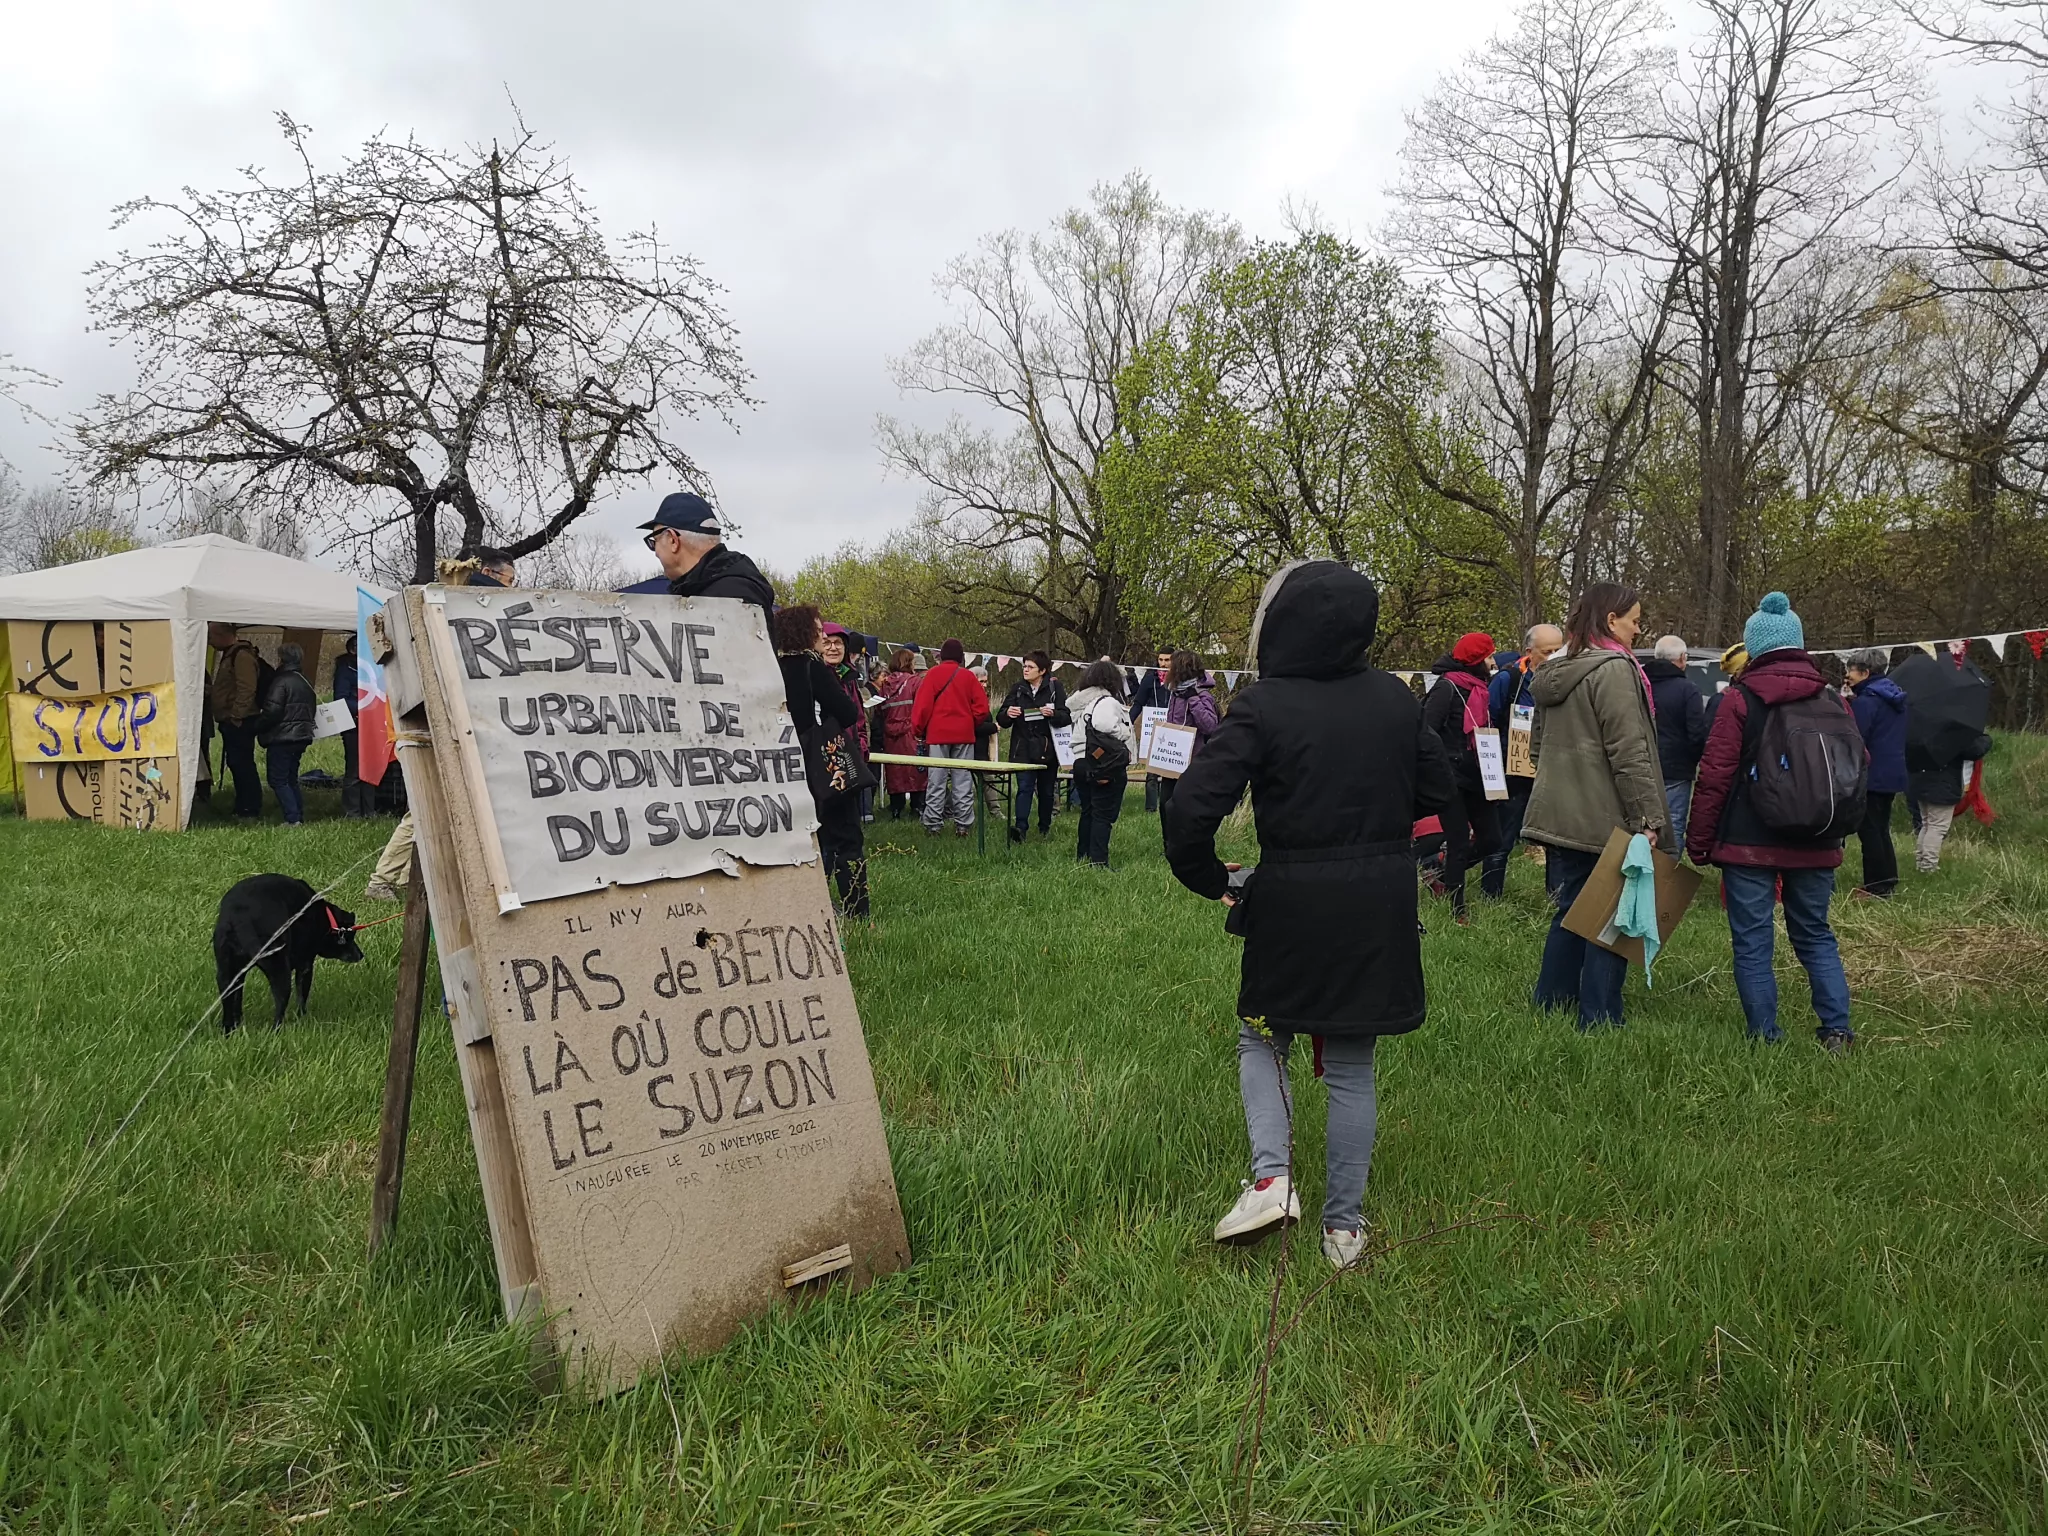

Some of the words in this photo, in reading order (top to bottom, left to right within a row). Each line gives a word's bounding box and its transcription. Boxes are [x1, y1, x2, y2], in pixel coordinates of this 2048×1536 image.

[448, 601, 724, 685] RÉSERVE
[33, 691, 158, 757] STOP
[498, 693, 681, 735] URBAINE
[698, 700, 745, 738] DE
[1511, 730, 1529, 744] NON
[523, 725, 806, 798] BIODIVERSITÉ
[1510, 758, 1522, 773] LE
[1522, 749, 1530, 759] O
[546, 806, 631, 863] DU
[644, 793, 793, 847] SUZON
[564, 915, 592, 935] IL
[666, 902, 707, 920] AURA
[510, 948, 626, 1022] PAS
[653, 946, 702, 999] de
[707, 918, 844, 989] BÉTON
[522, 1030, 594, 1099] LÀ
[611, 1009, 670, 1077] OÙ
[693, 994, 832, 1058] COULE
[543, 1098, 614, 1171] LE
[646, 1048, 838, 1140] SUZON
[665, 1153, 682, 1168] LE
[698, 1142, 716, 1158] 20
[720, 1128, 781, 1151] NOVEMBRE
